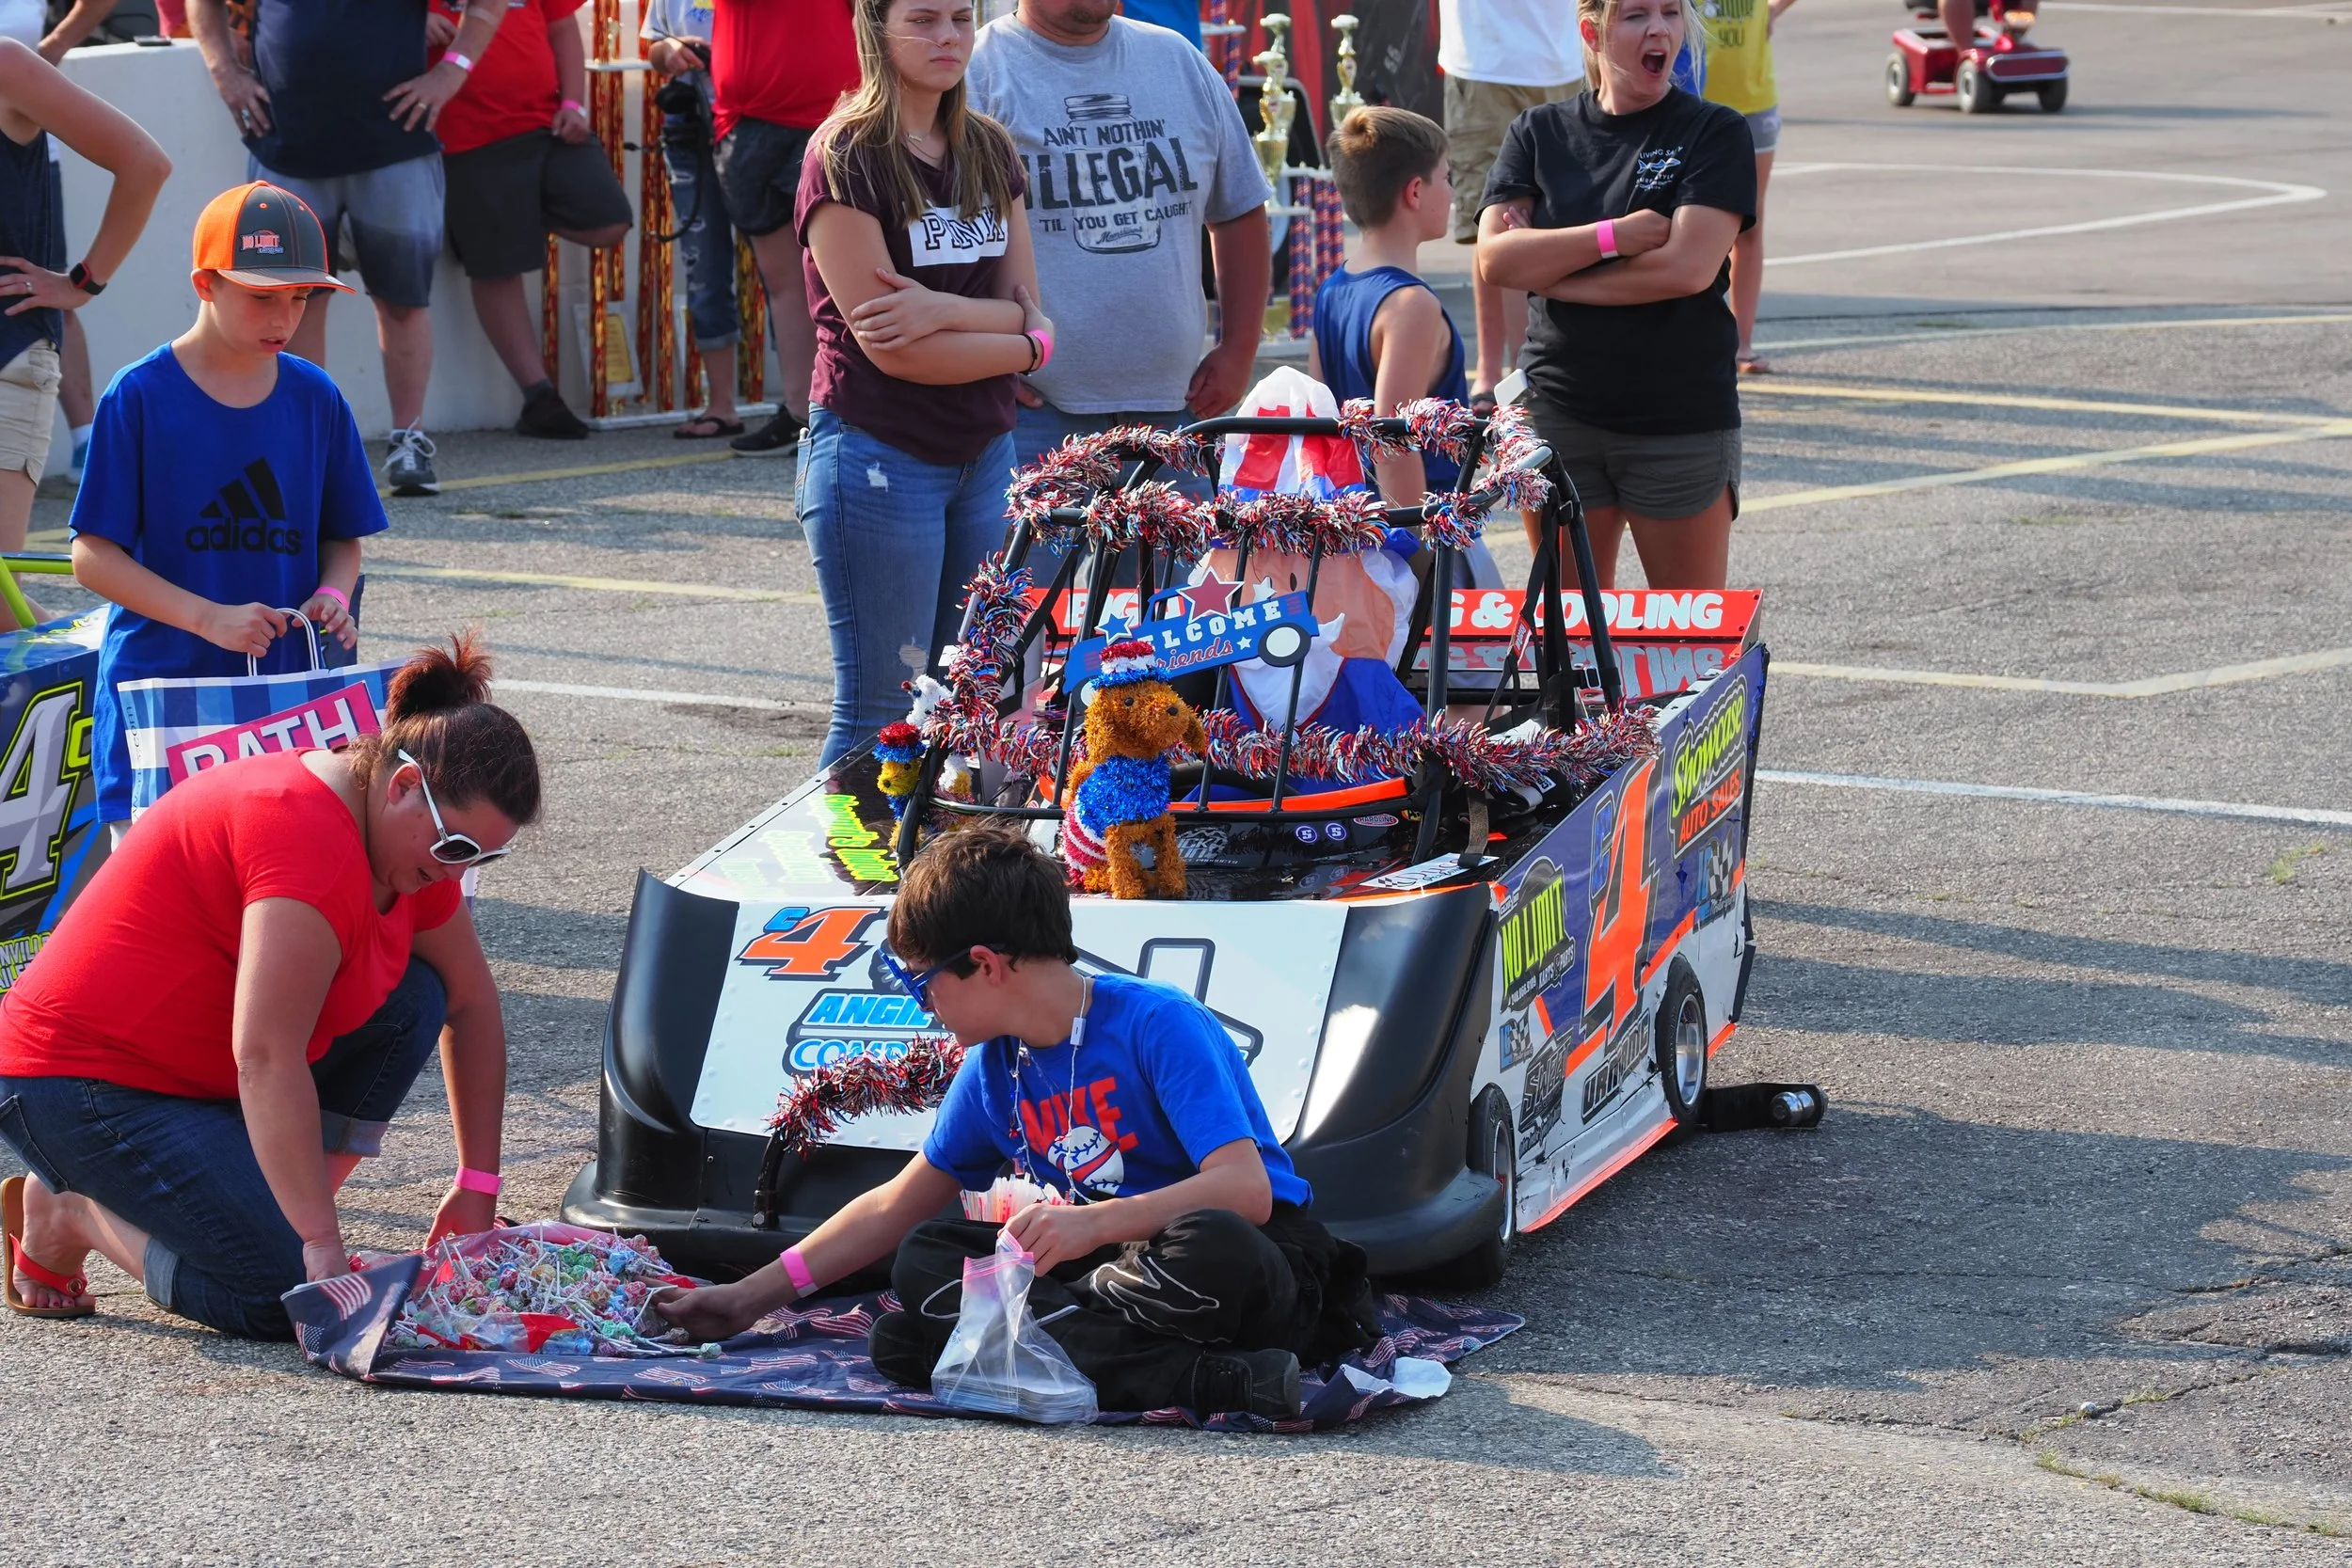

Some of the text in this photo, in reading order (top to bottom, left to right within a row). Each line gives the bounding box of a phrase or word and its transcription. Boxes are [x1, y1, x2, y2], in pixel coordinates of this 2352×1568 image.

[1718, 28, 1745, 48] YOU
[1043, 119, 1166, 147] AIN'T NOTHIN'
[1639, 146, 1683, 159] LIVING SAY
[1020, 136, 1198, 210] ILLEGAL
[1073, 215, 1106, 230] YOU
[1113, 211, 1137, 226] GET
[185, 518, 302, 556] adidas
[1137, 600, 1280, 649] LCOME
[1471, 593, 1512, 628] &
[1156, 637, 1233, 670] riends
[1673, 695, 1743, 818] Showcase
[1678, 768, 1740, 847] AUTO SALES
[1501, 913, 1523, 998] NO
[1523, 876, 1565, 969] LIMIT
[1020, 1076, 1139, 1158] NIKE
